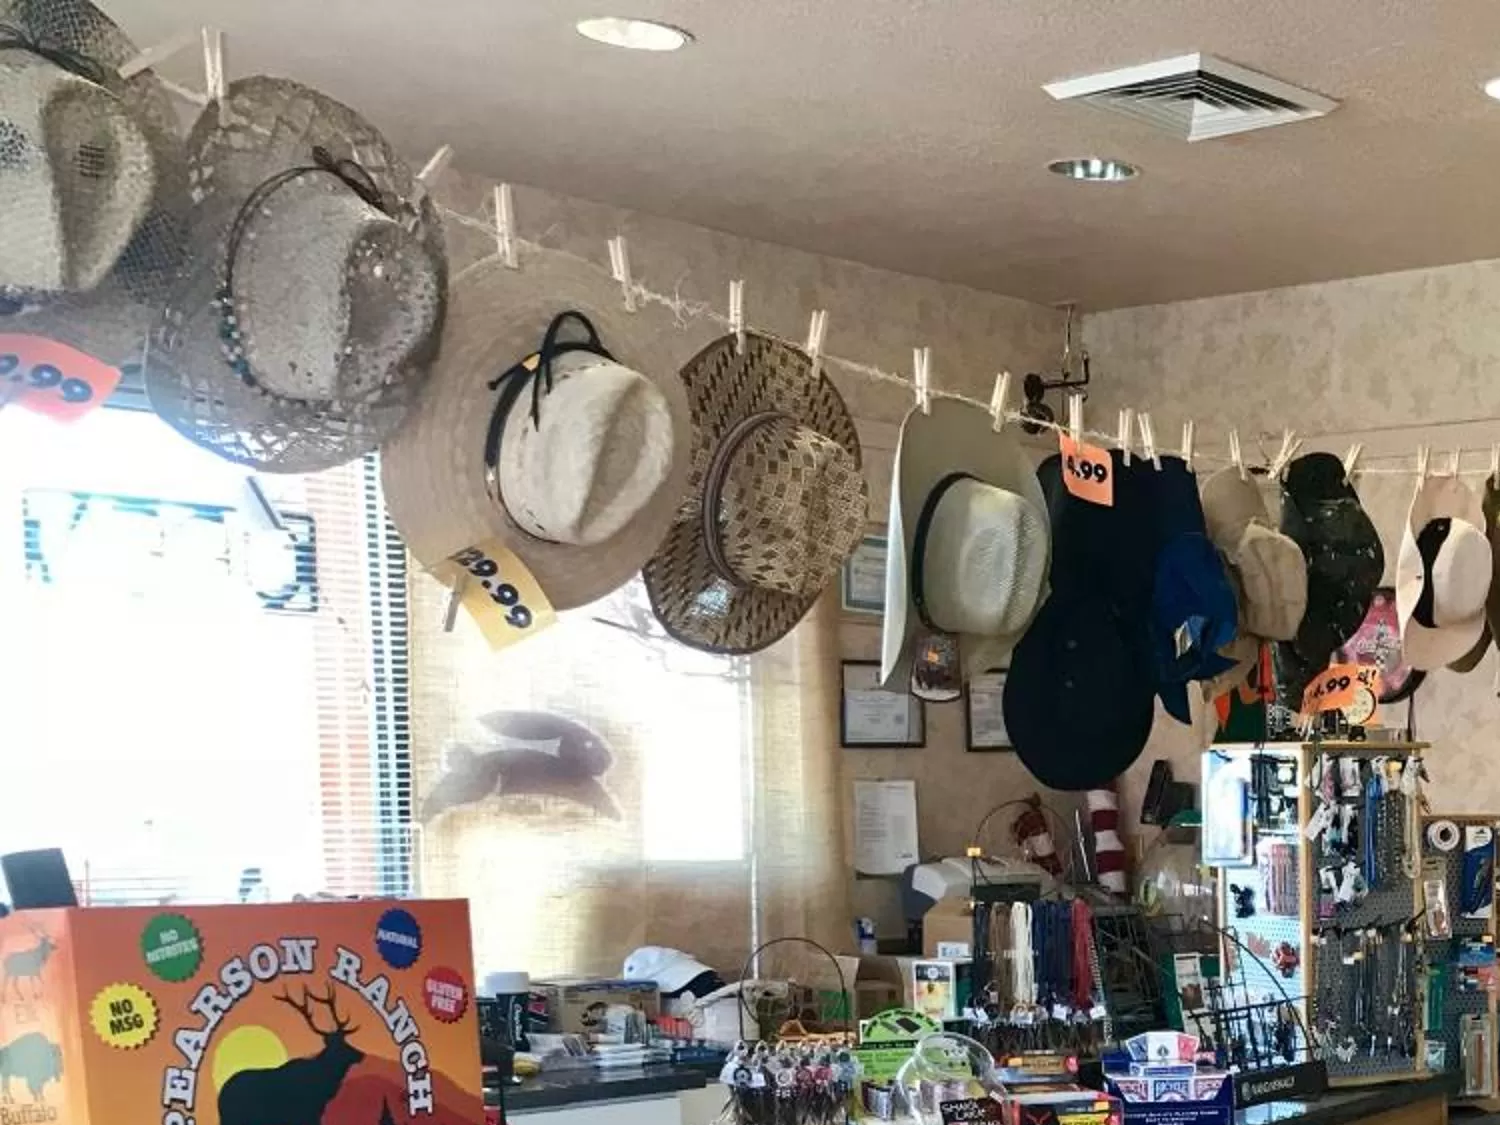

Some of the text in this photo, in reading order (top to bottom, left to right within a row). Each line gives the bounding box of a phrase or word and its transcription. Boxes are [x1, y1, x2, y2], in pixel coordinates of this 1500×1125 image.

[109, 998, 133, 1016] NO
[431, 995, 456, 1013] FREE
[109, 1014, 144, 1036] MSG
[328, 945, 436, 1117] RANCH
